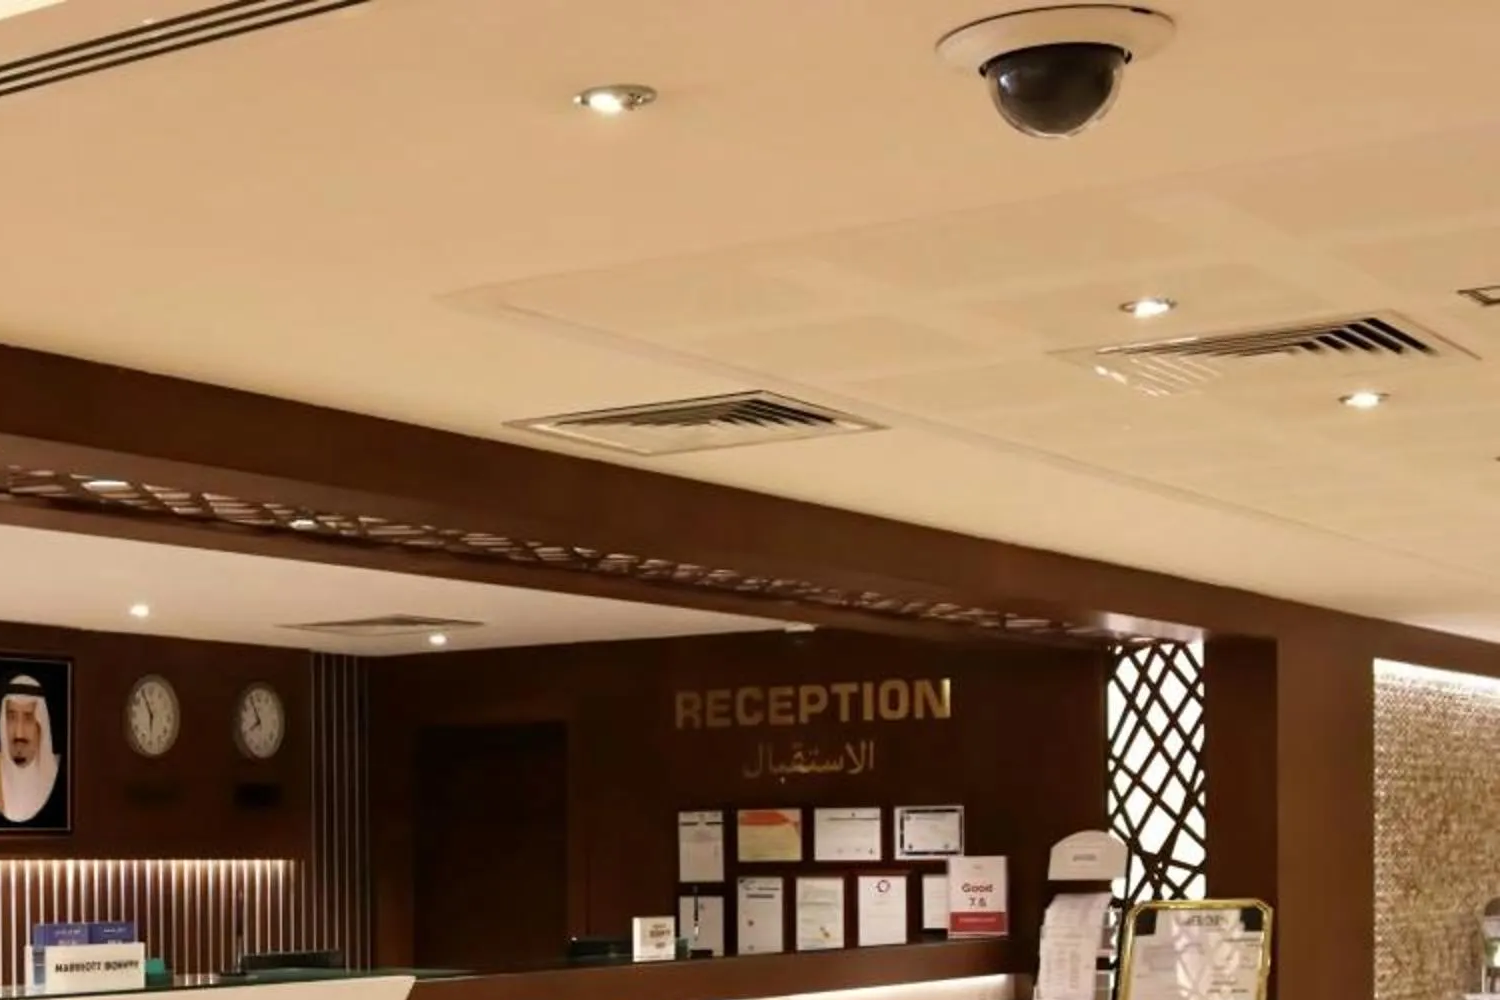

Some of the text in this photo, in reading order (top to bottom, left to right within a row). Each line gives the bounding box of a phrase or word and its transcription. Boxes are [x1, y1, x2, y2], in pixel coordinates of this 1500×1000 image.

[675, 677, 951, 729] RECEPTION
[741, 739, 875, 785] الاستقبال
[961, 882, 994, 893] Good
